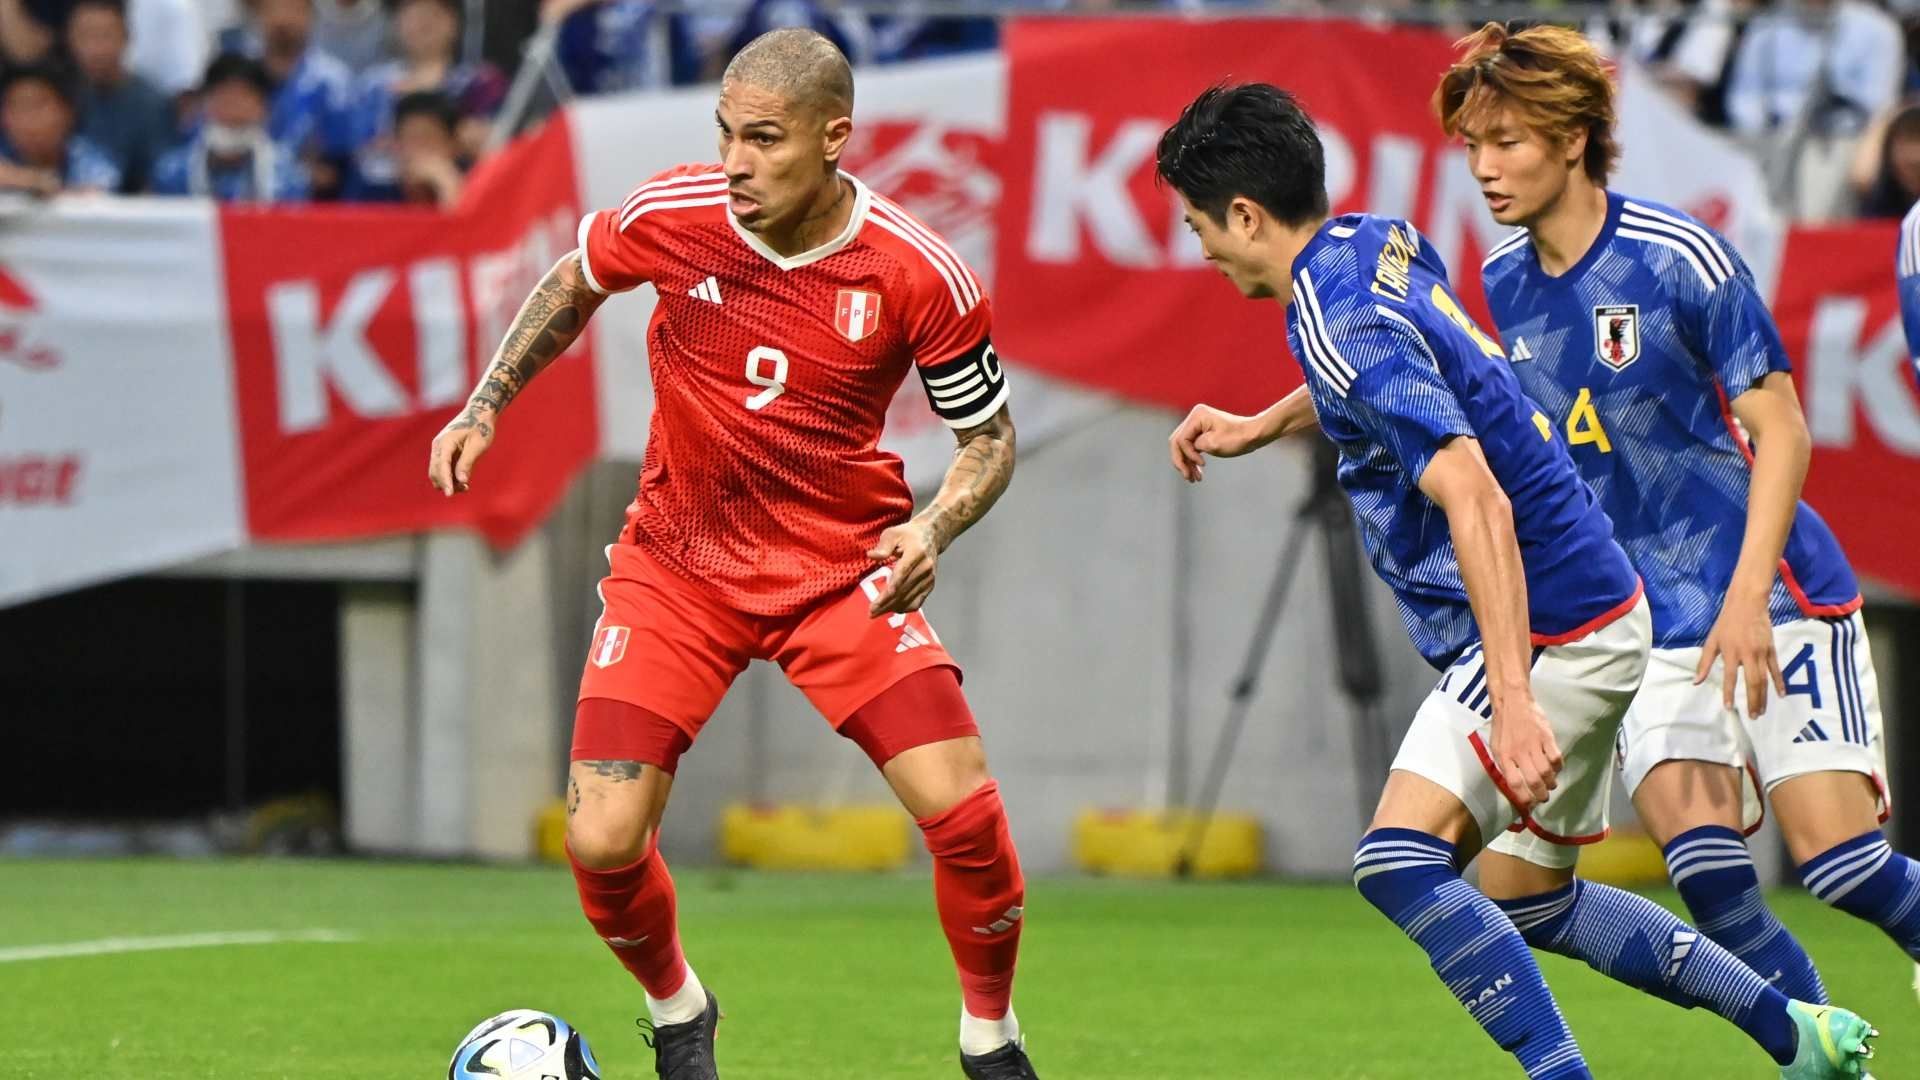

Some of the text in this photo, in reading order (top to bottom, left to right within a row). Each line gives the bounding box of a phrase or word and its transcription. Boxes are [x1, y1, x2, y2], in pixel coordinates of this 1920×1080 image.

[841, 307, 874, 320] FPF
[745, 345, 789, 410] 9
[1566, 387, 1612, 453] 4
[1782, 643, 1822, 709] 4
